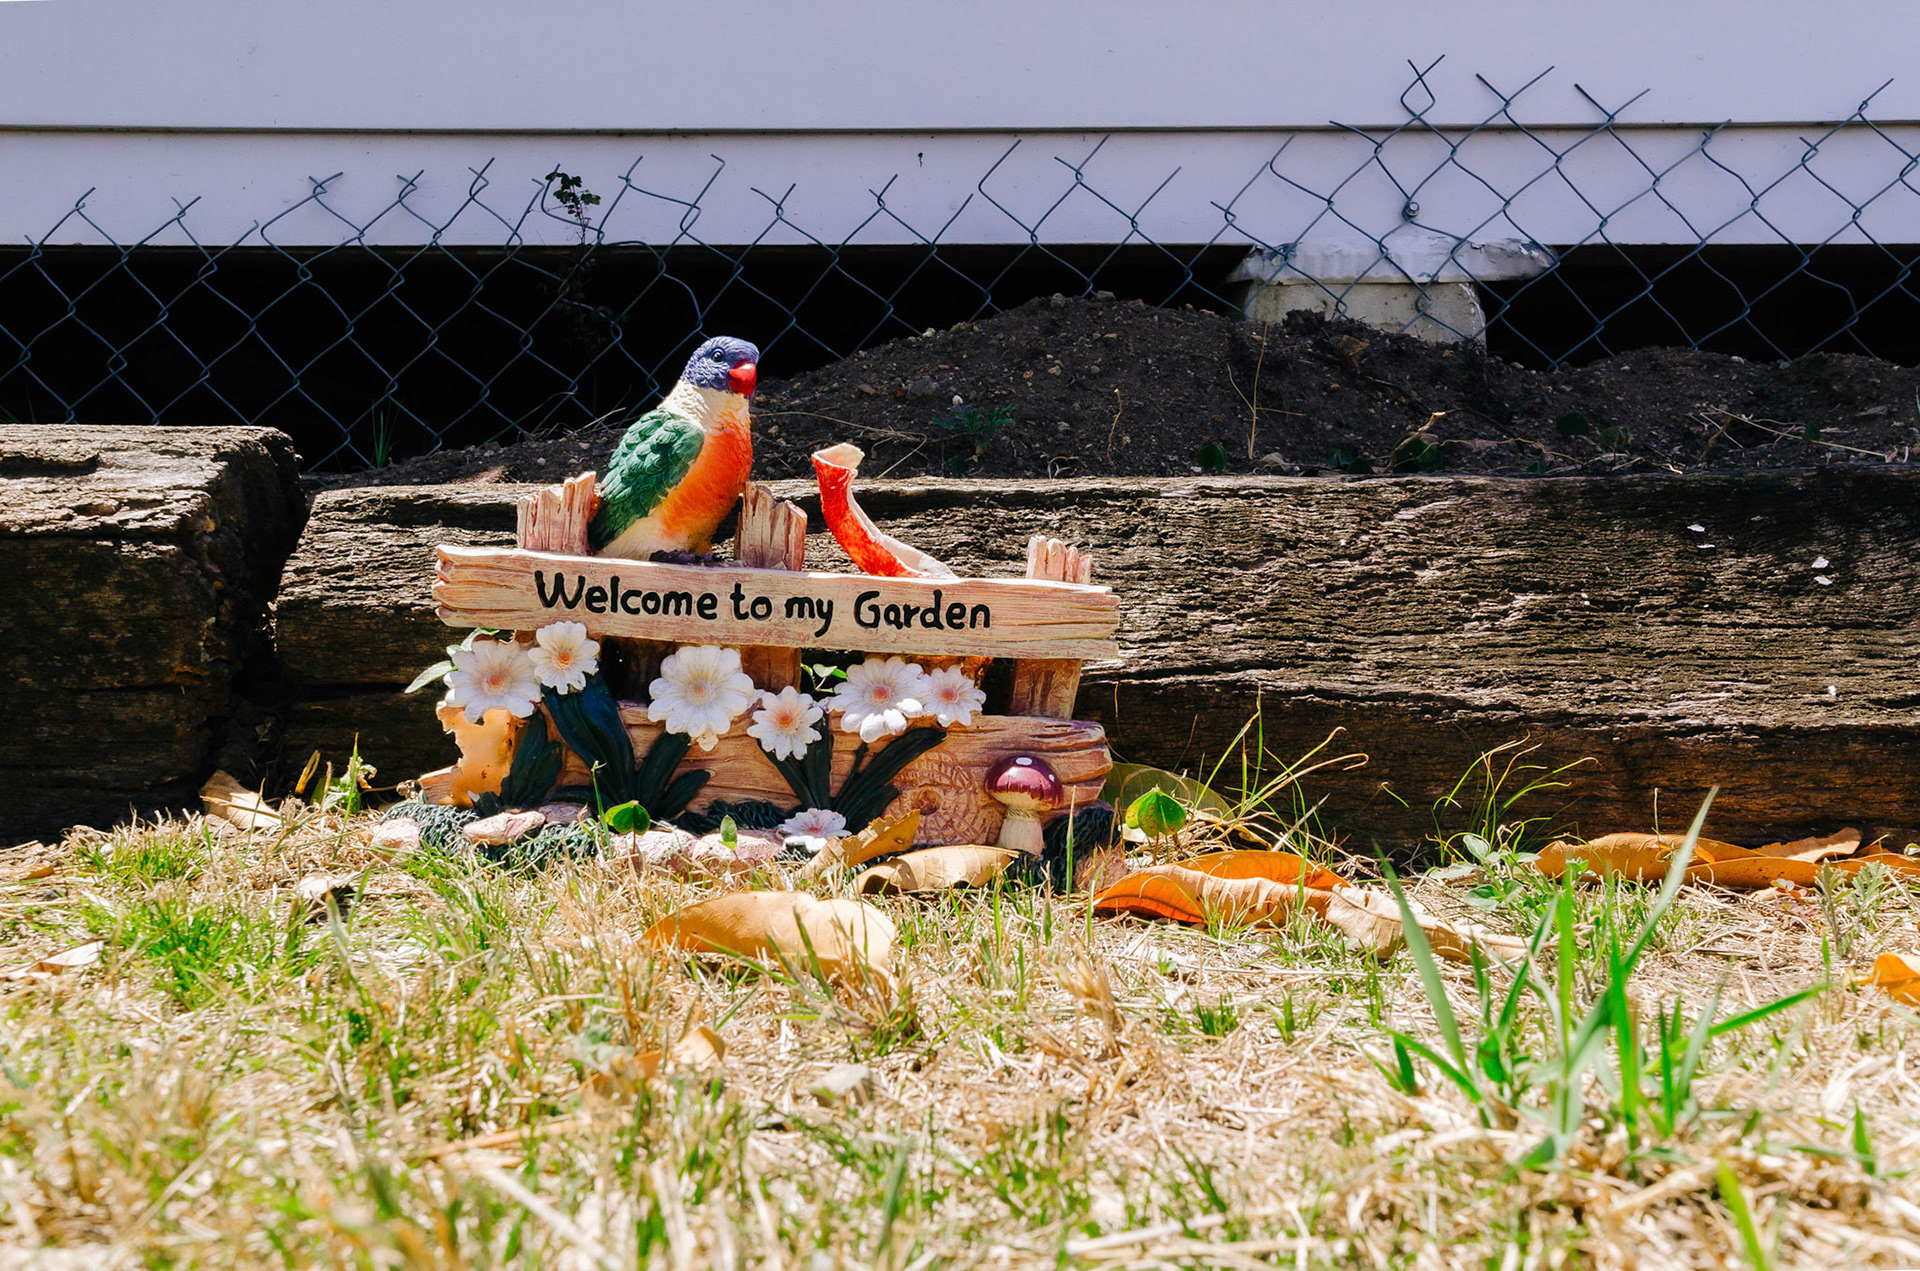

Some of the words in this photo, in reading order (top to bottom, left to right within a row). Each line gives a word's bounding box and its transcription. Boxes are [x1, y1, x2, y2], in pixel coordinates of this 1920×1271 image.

[533, 569, 718, 621] Welcome
[730, 581, 773, 621] to
[783, 596, 834, 638] my
[853, 589, 991, 632] Garden
